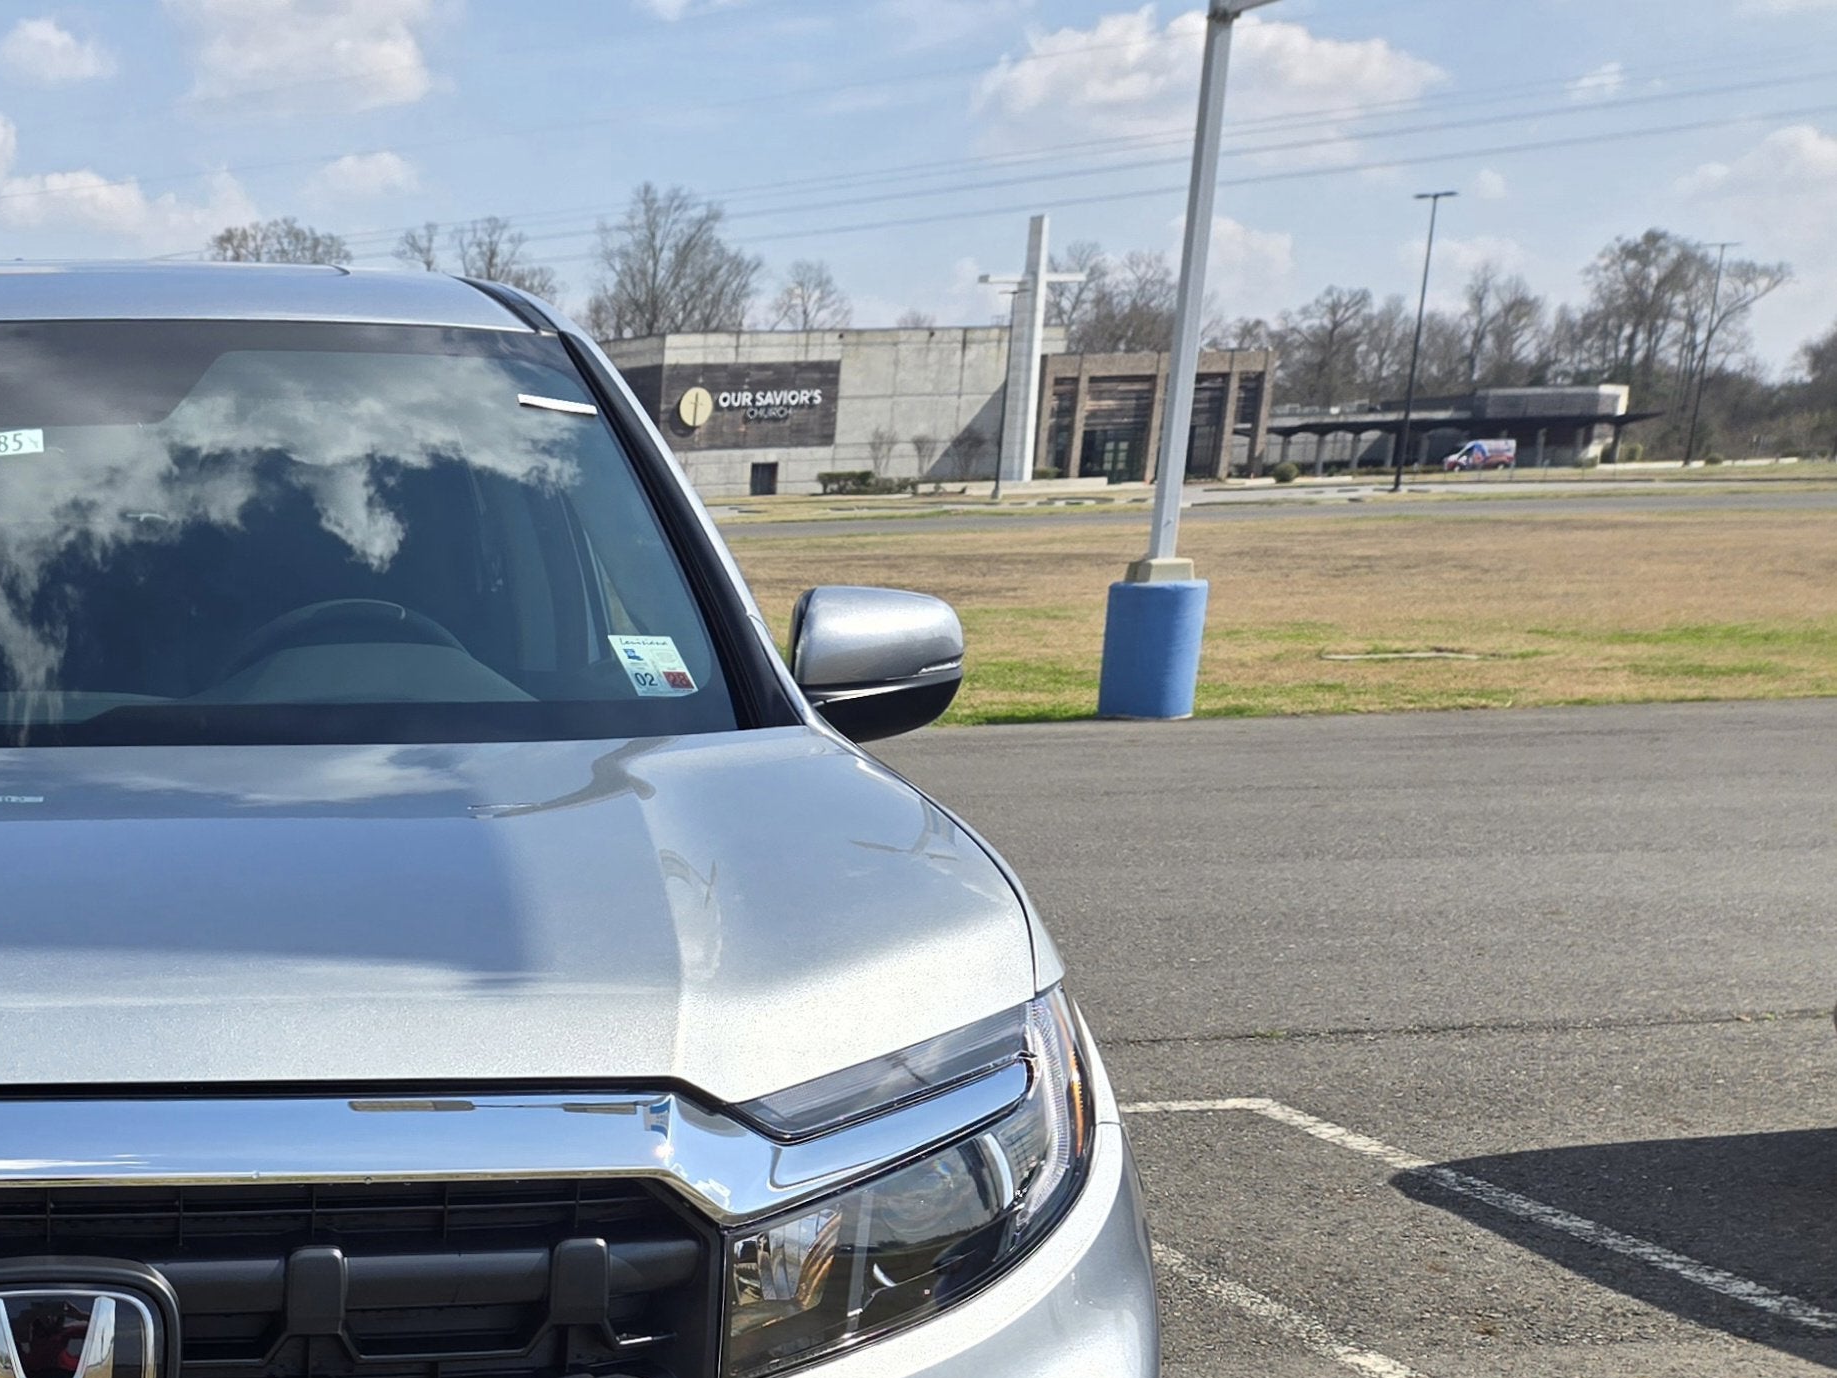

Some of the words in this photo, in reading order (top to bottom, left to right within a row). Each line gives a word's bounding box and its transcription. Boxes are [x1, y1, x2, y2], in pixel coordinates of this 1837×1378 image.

[718, 391, 753, 408] OUR
[755, 388, 823, 407] SAVIOR'S
[634, 672, 659, 687] 02
